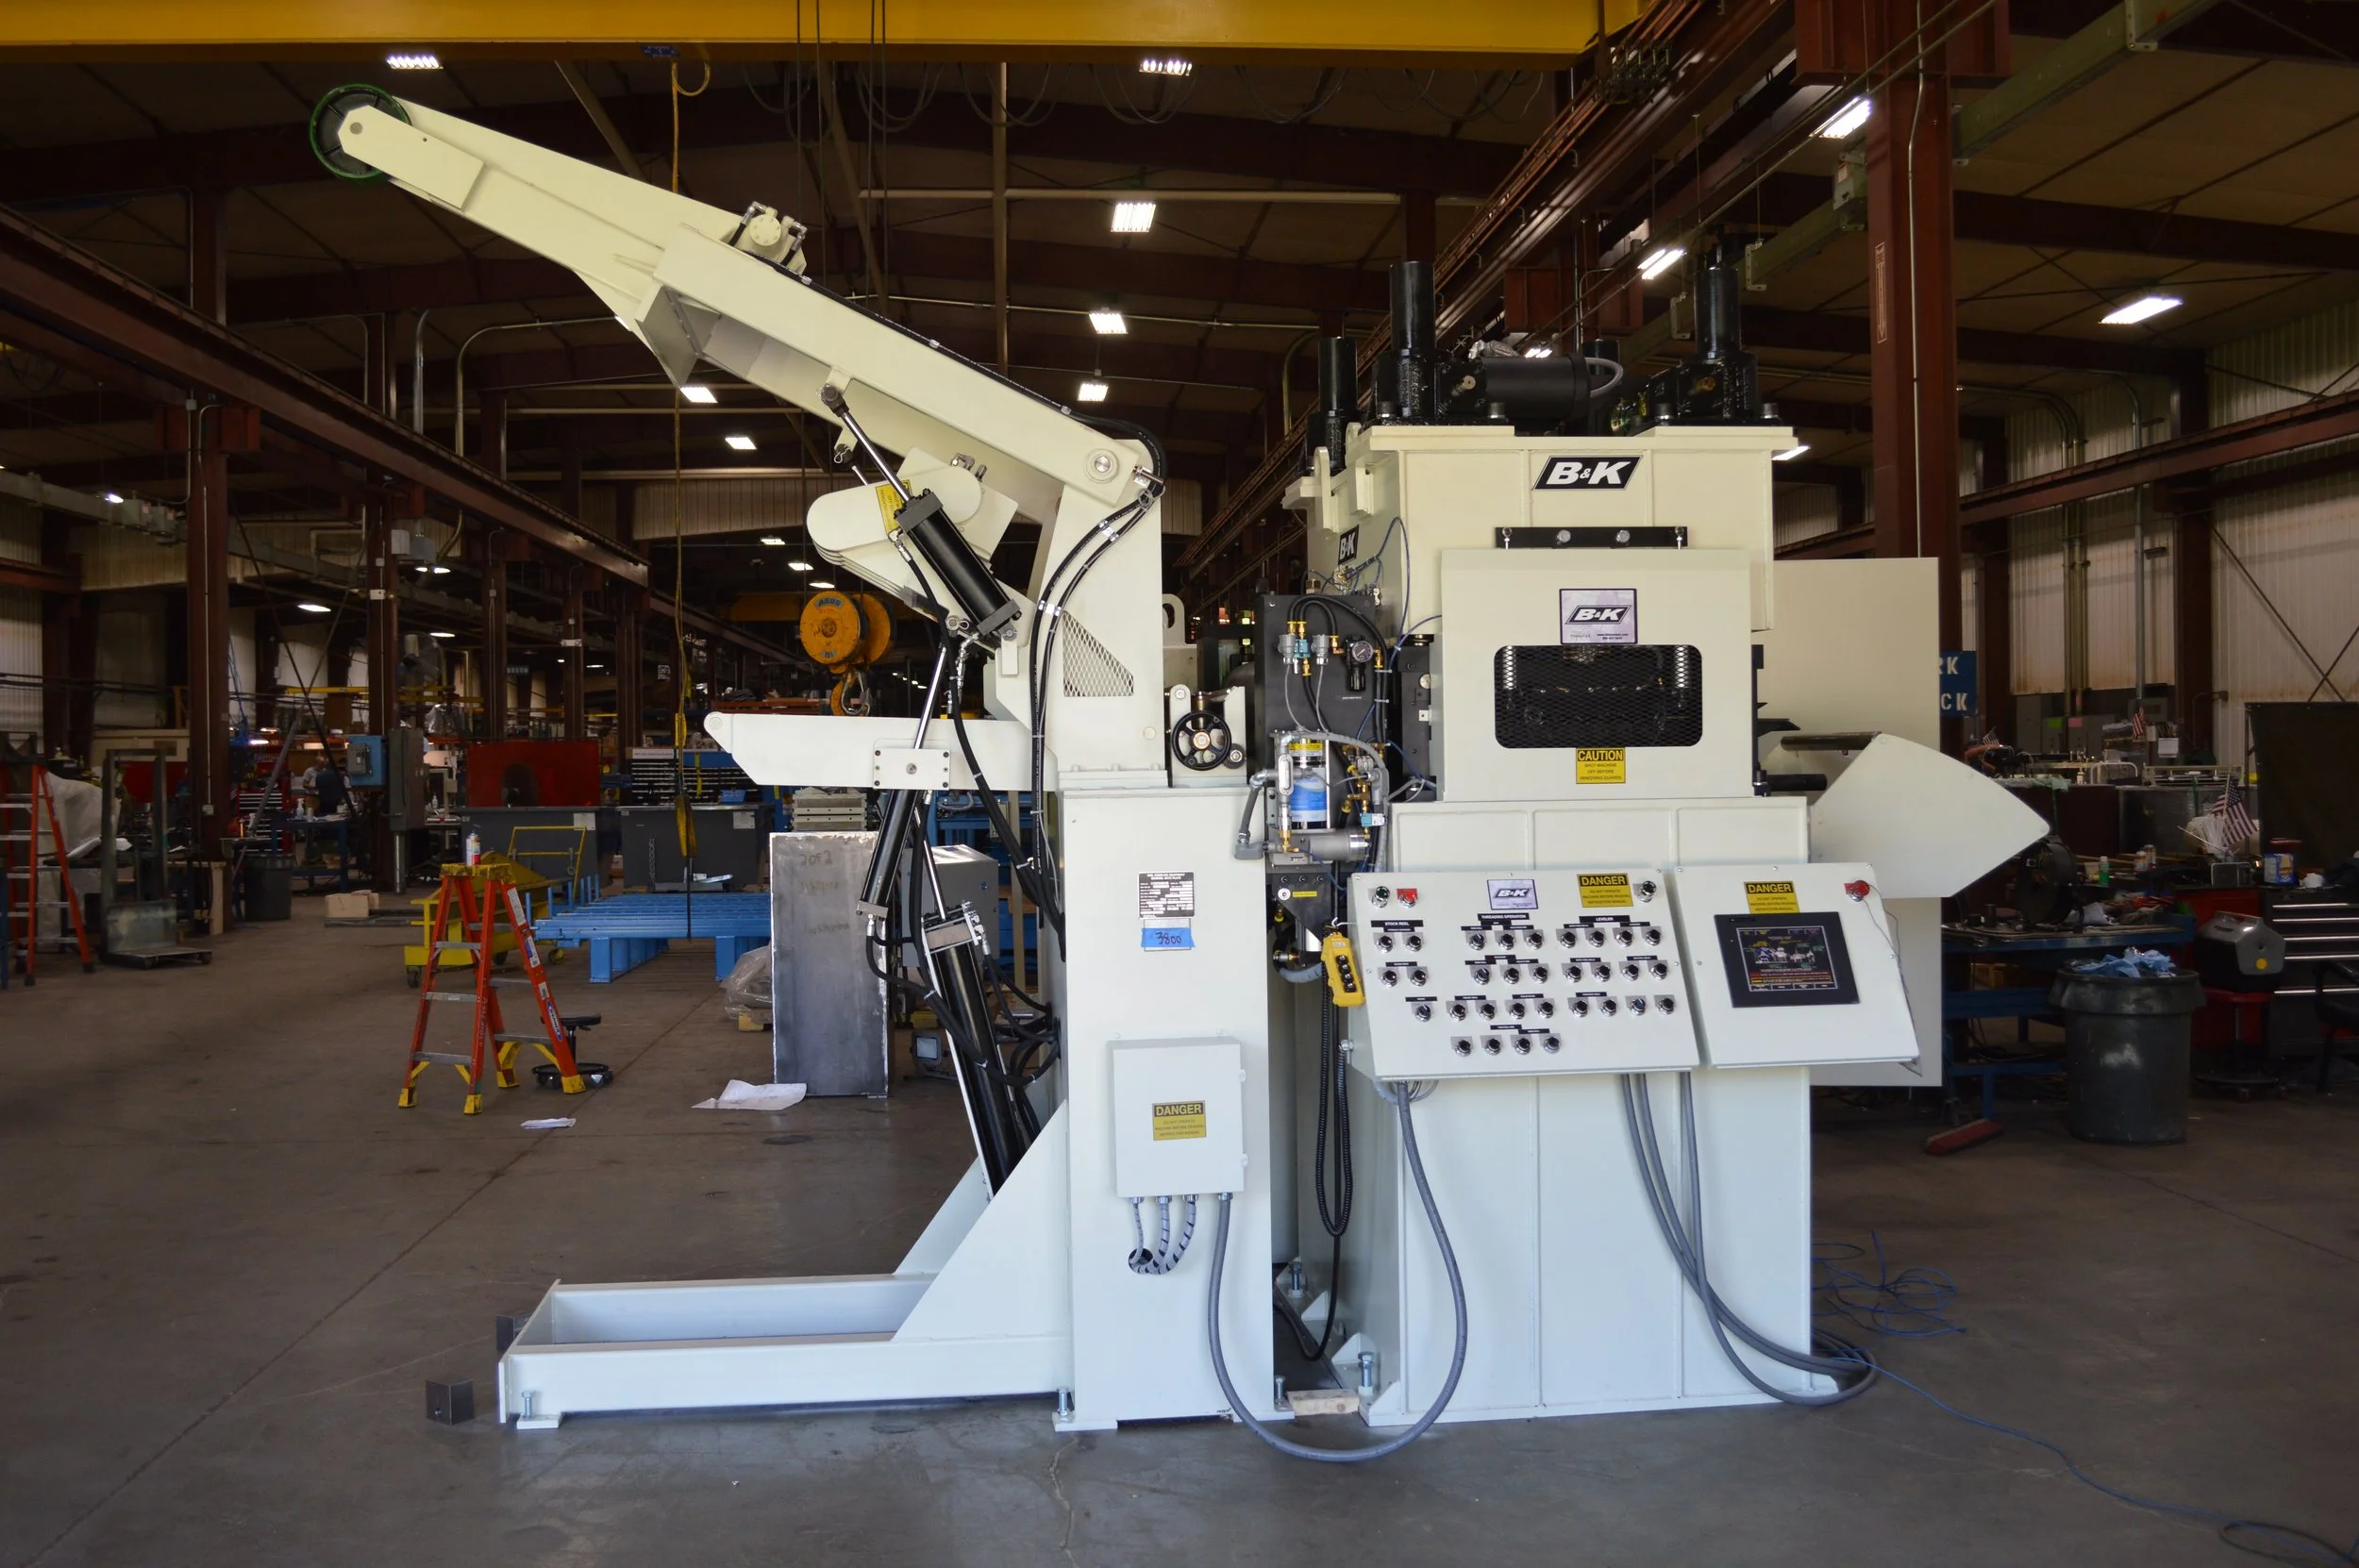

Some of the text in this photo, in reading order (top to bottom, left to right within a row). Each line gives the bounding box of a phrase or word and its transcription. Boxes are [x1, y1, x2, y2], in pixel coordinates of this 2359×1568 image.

[1546, 461, 1631, 485] B&K
[1339, 532, 1356, 560] B&K
[1574, 608, 1625, 621] B&K
[1578, 750, 1623, 761] CAUTION
[1581, 876, 1626, 886] DANGER
[1748, 884, 1792, 892] DANGER
[1155, 932, 1182, 945] 3800
[1156, 1104, 1201, 1116] DANGER
